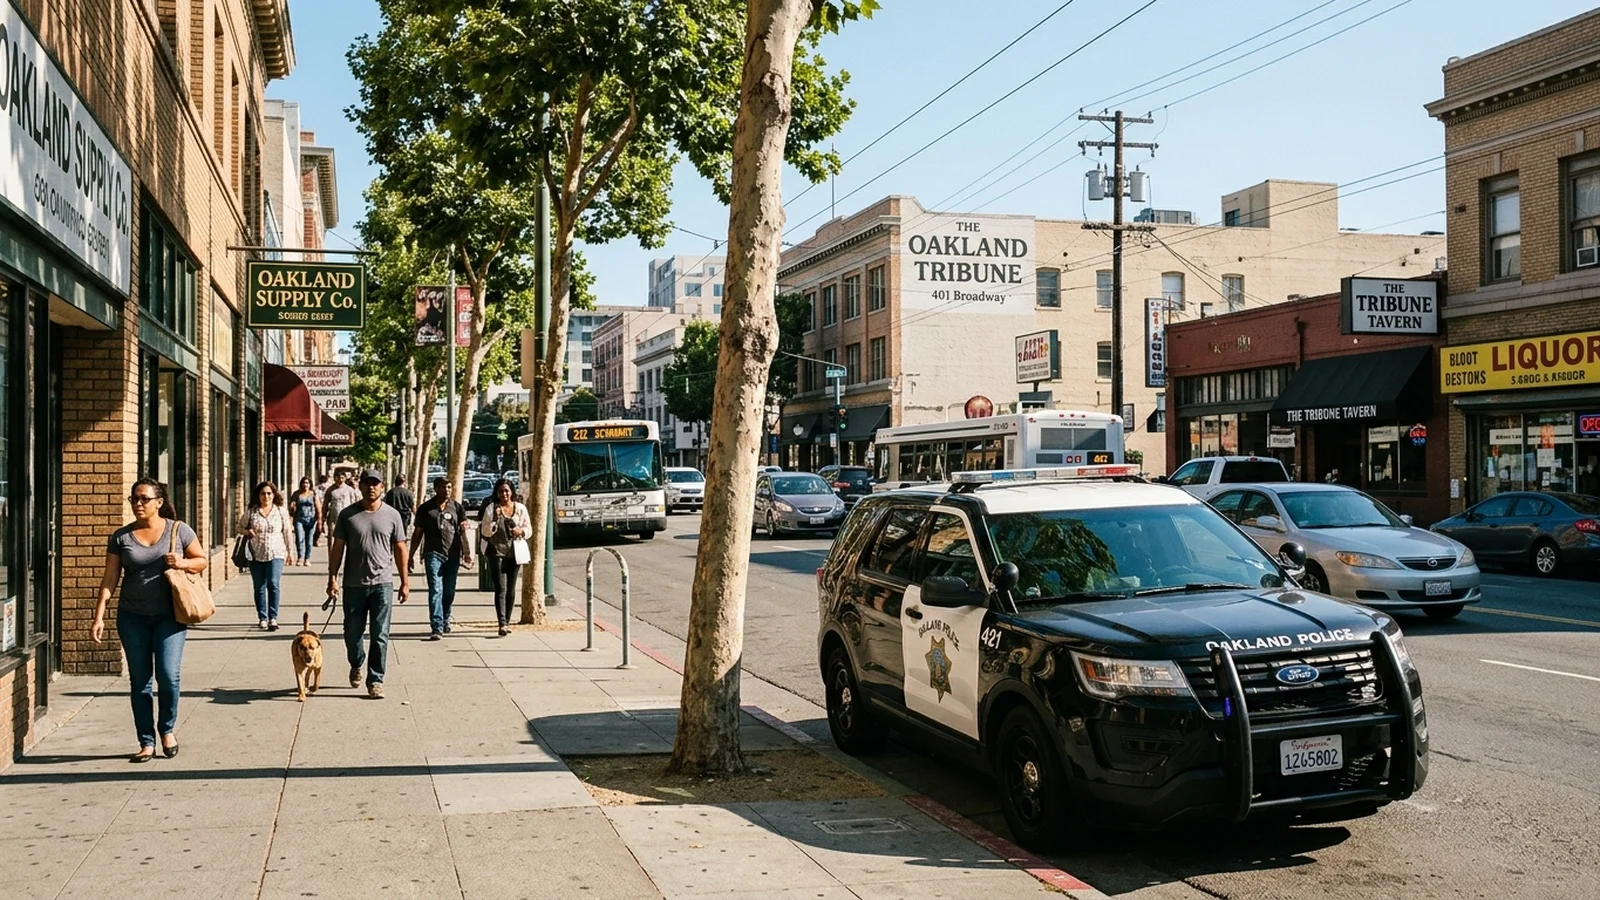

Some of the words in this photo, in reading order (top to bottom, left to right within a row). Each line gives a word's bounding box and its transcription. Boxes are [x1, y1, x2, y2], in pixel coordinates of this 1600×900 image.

[0, 23, 71, 173] OAKLAND
[75, 120, 114, 221] SUPPLY
[956, 222, 980, 232] THE
[908, 234, 1028, 258] OAKLAND
[258, 270, 355, 289] OAKLAND
[914, 261, 1022, 284] TRIBUNE
[931, 290, 950, 301] 401
[953, 290, 1006, 304] Broadway
[1383, 283, 1405, 294] THE
[256, 290, 325, 308] SUPPLY
[330, 292, 357, 309] Co.
[1356, 295, 1433, 313] TRIBUNE
[1367, 315, 1422, 328] TAVERN
[1492, 335, 1600, 372] LIQUOR
[326, 399, 347, 408] PAN
[1287, 410, 1303, 422] THE
[1342, 405, 1377, 419] TAVERN
[981, 627, 1002, 649] 421
[1205, 635, 1292, 652] OAKLAND
[1285, 748, 1338, 770] 1265802
